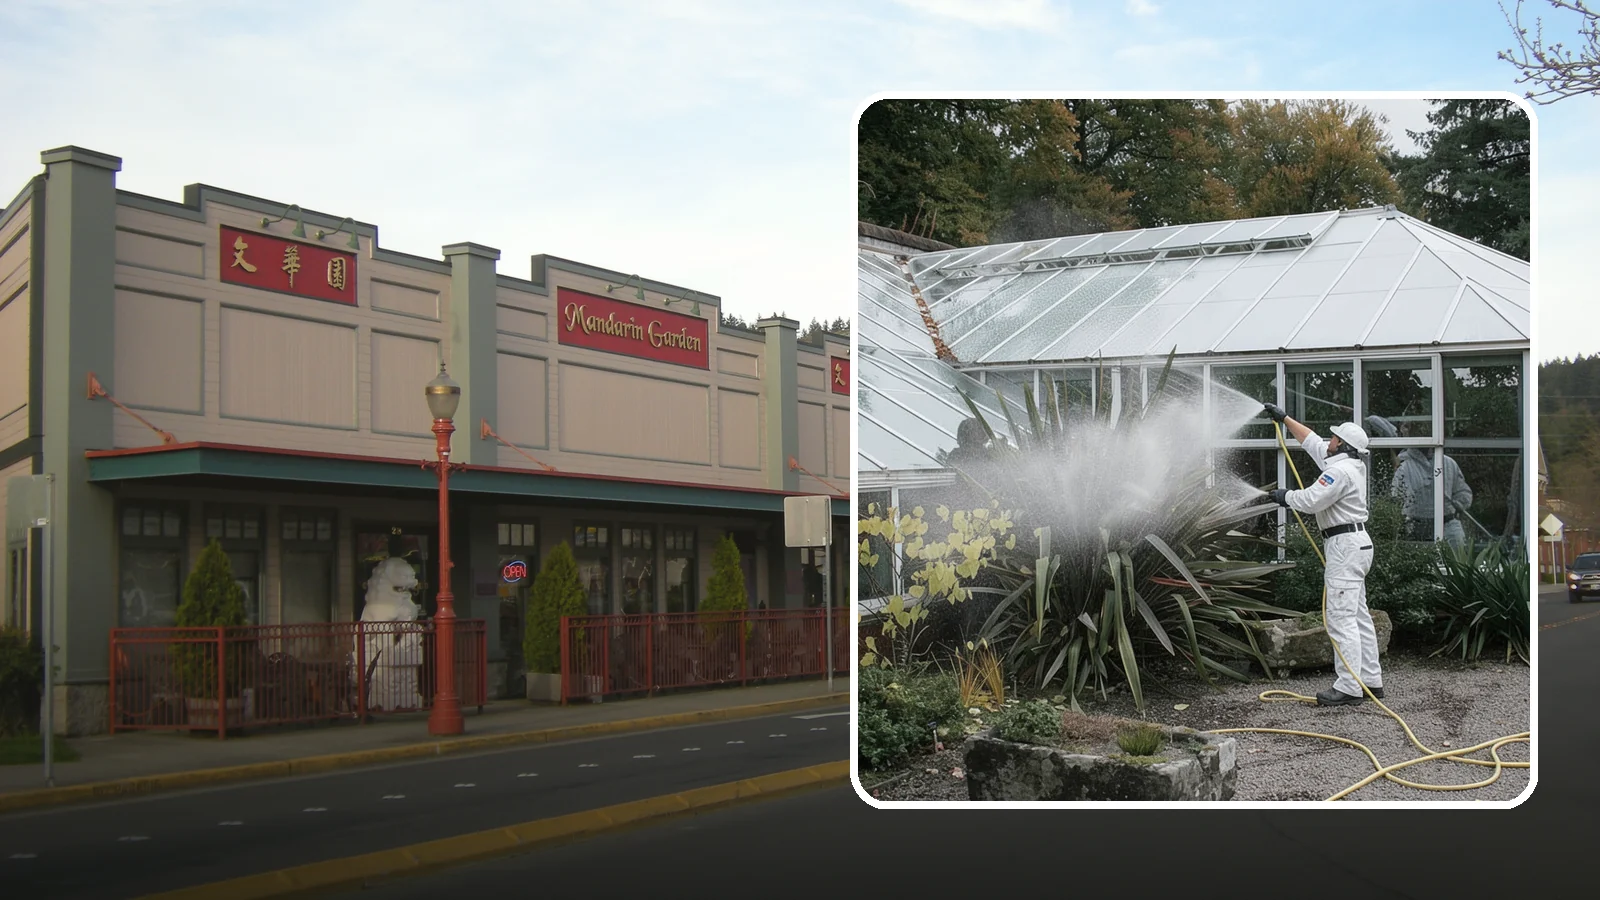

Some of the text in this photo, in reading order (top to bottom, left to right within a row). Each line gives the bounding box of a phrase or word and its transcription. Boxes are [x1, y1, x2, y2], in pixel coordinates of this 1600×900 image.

[230, 235, 346, 291] 文華園
[564, 302, 702, 352] Mandarin Garden
[503, 565, 527, 578] OPEN
